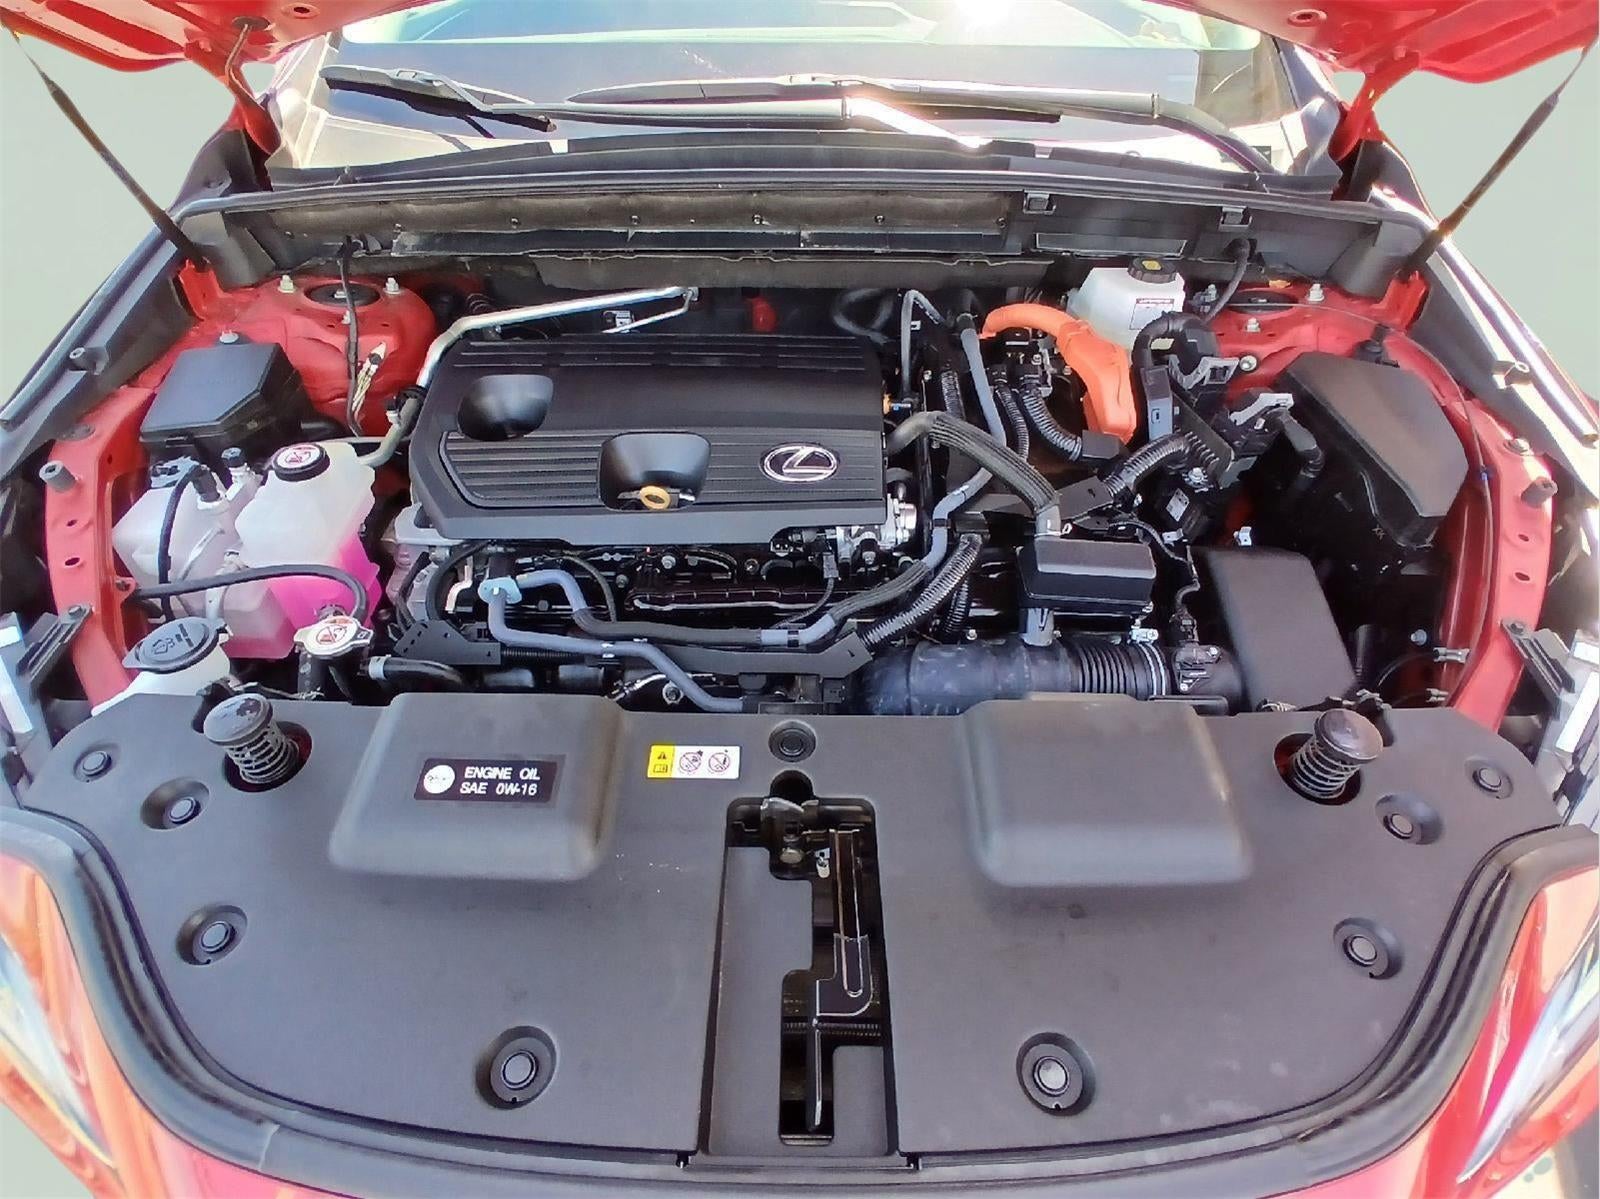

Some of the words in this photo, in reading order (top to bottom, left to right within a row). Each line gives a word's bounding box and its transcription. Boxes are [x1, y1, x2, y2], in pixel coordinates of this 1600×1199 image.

[464, 766, 513, 780] ENGINE
[519, 767, 541, 781] OIL
[460, 781, 489, 795] SAE
[495, 782, 538, 796] 0W-16
